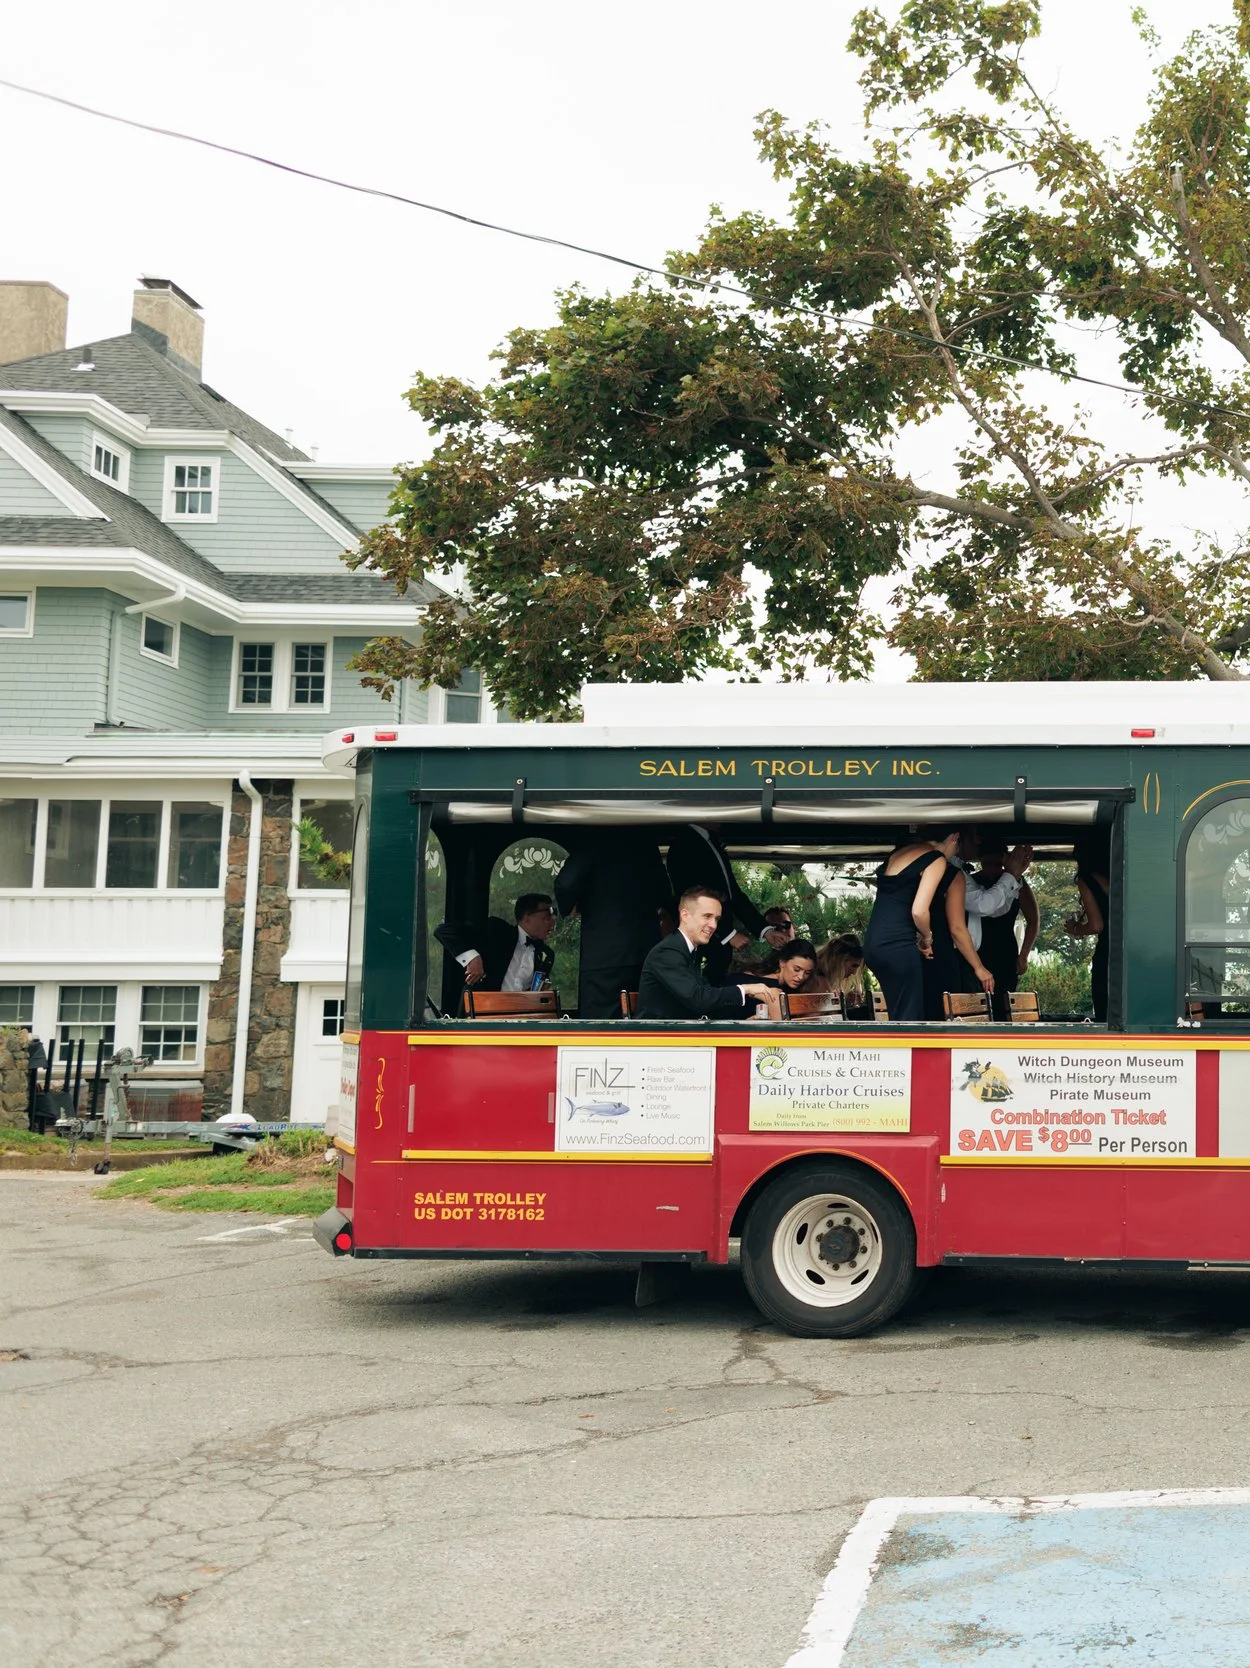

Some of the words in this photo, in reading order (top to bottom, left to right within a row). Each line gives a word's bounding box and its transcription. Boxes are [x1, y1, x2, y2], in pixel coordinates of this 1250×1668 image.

[639, 760, 736, 777] SALEM
[750, 760, 880, 776] TROLLEY
[892, 760, 941, 776] INC.
[813, 1050, 845, 1062] MAHI
[849, 1050, 881, 1062] MAHI
[1017, 1055, 1057, 1067] Witch
[1060, 1055, 1122, 1070] Dungeon
[1126, 1055, 1185, 1068] Museum
[647, 1066, 666, 1074] Fresh
[667, 1066, 695, 1074] Seafood
[787, 1066, 832, 1078] CRUISES
[835, 1067, 846, 1078] &
[850, 1066, 906, 1078] CHARTERS
[575, 1058, 636, 1097] FINZ
[1023, 1072, 1063, 1084] Witch
[1066, 1072, 1116, 1087] History
[1119, 1072, 1178, 1085] Museum
[758, 1083, 796, 1099] Daily
[800, 1084, 850, 1097] Harbor
[853, 1084, 905, 1098] Cruises
[1049, 1088, 1089, 1101] Pirate
[1093, 1088, 1152, 1101] Museum
[792, 1100, 826, 1110] Private
[828, 1100, 870, 1110] Charters
[646, 1112, 659, 1120] Live
[661, 1112, 681, 1120] Music
[776, 1112, 793, 1120] Daily
[832, 1117, 854, 1127] (800)
[855, 1117, 871, 1127] 992
[879, 1117, 908, 1127] MAHI
[990, 1108, 1106, 1126] Combination
[1110, 1108, 1168, 1126] Ticket
[753, 1120, 773, 1128] Salem
[774, 1120, 800, 1128] Willows
[565, 1132, 706, 1146] www.FinzSeafood.com
[957, 1128, 1034, 1152] SAVE
[1098, 1136, 1126, 1154] Per
[1130, 1136, 1189, 1154] Person
[414, 1192, 469, 1206] SALEM
[473, 1192, 547, 1206] TROLLEY
[414, 1207, 437, 1220] US
[440, 1207, 474, 1220] DOT
[478, 1208, 545, 1221] 3178162
